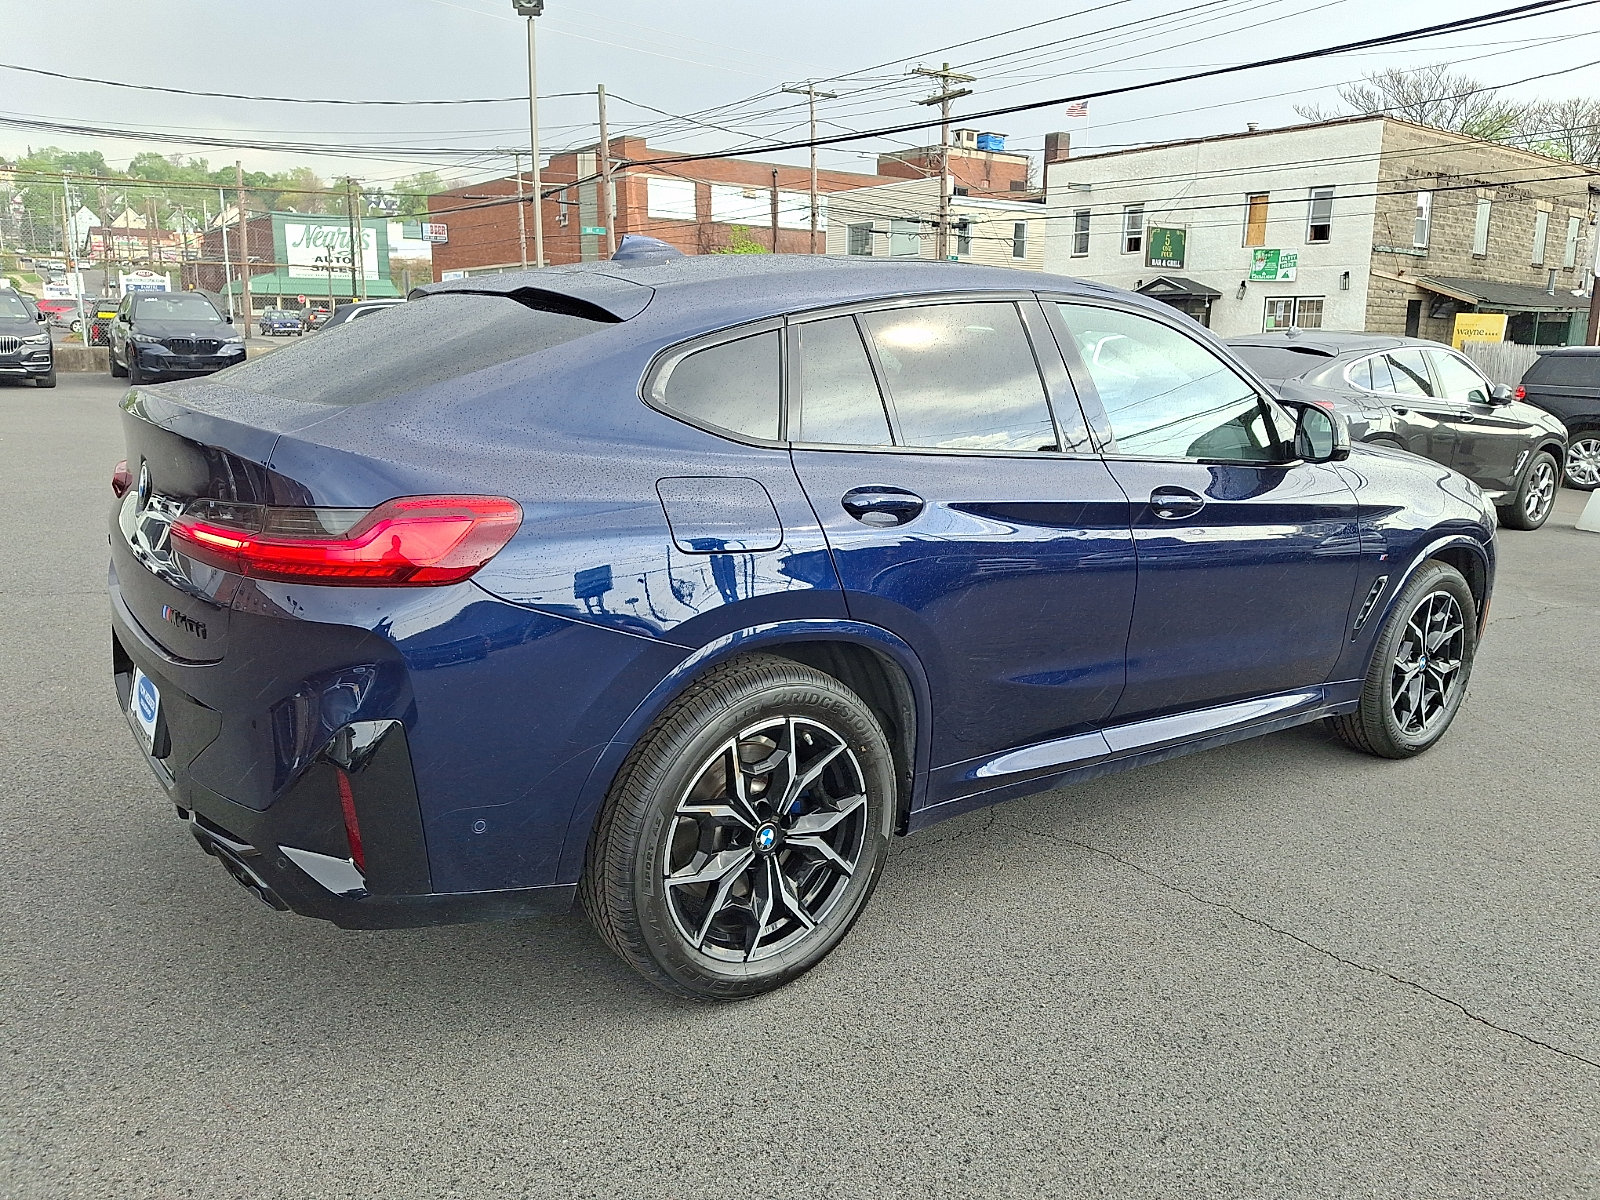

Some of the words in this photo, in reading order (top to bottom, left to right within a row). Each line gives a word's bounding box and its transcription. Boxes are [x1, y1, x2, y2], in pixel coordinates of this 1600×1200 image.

[430, 225, 446, 236] BEER
[1165, 234, 1170, 246] 5
[314, 255, 352, 265] AUTO
[1152, 258, 1161, 266] BAR
[310, 264, 358, 274] SALES
[1456, 328, 1485, 338] wayne
[770, 690, 879, 756] BRIDGESTONE
[643, 844, 655, 890] SPORT
